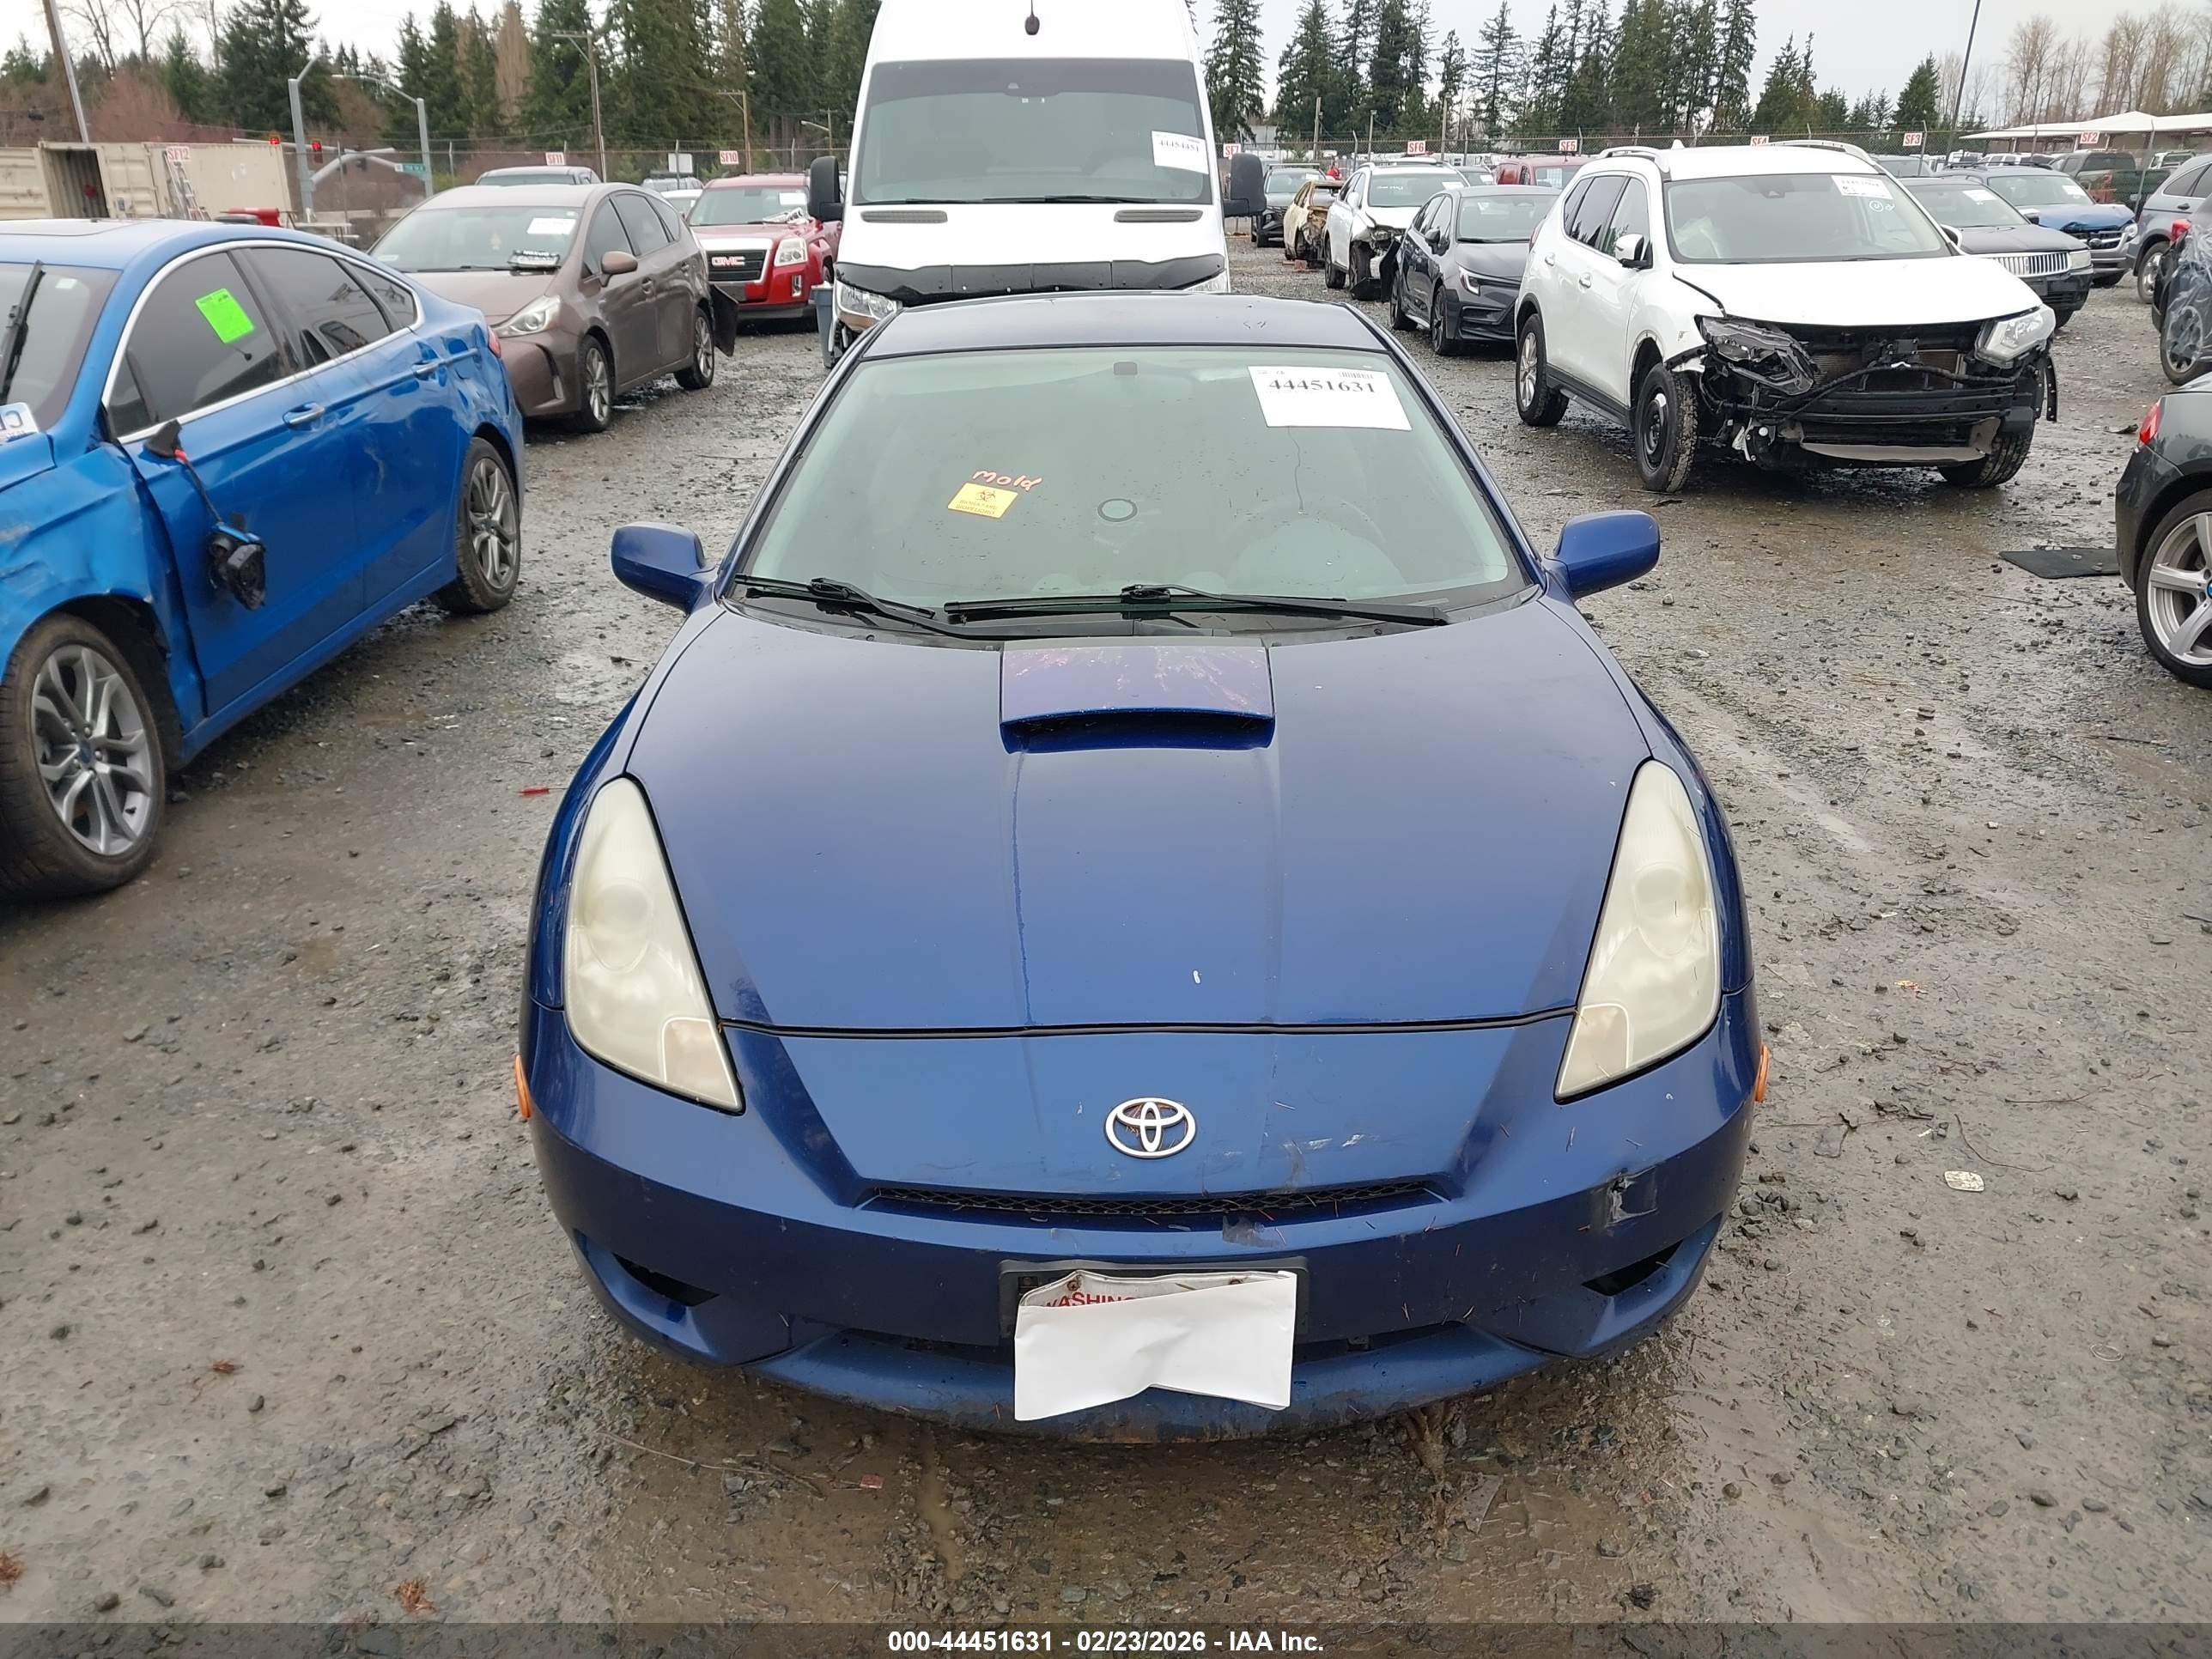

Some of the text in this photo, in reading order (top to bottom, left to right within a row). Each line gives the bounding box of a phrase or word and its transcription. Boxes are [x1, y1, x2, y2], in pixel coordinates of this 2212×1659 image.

[1752, 137, 1767, 146] SF4
[1905, 134, 1921, 144] SF3
[2081, 132, 2097, 143] SF2
[1225, 145, 1239, 155] SF7
[1409, 143, 1424, 153] SF6
[1561, 141, 1576, 151] SF5
[711, 256, 745, 266] GMC
[1269, 379, 1375, 393] 44451631
